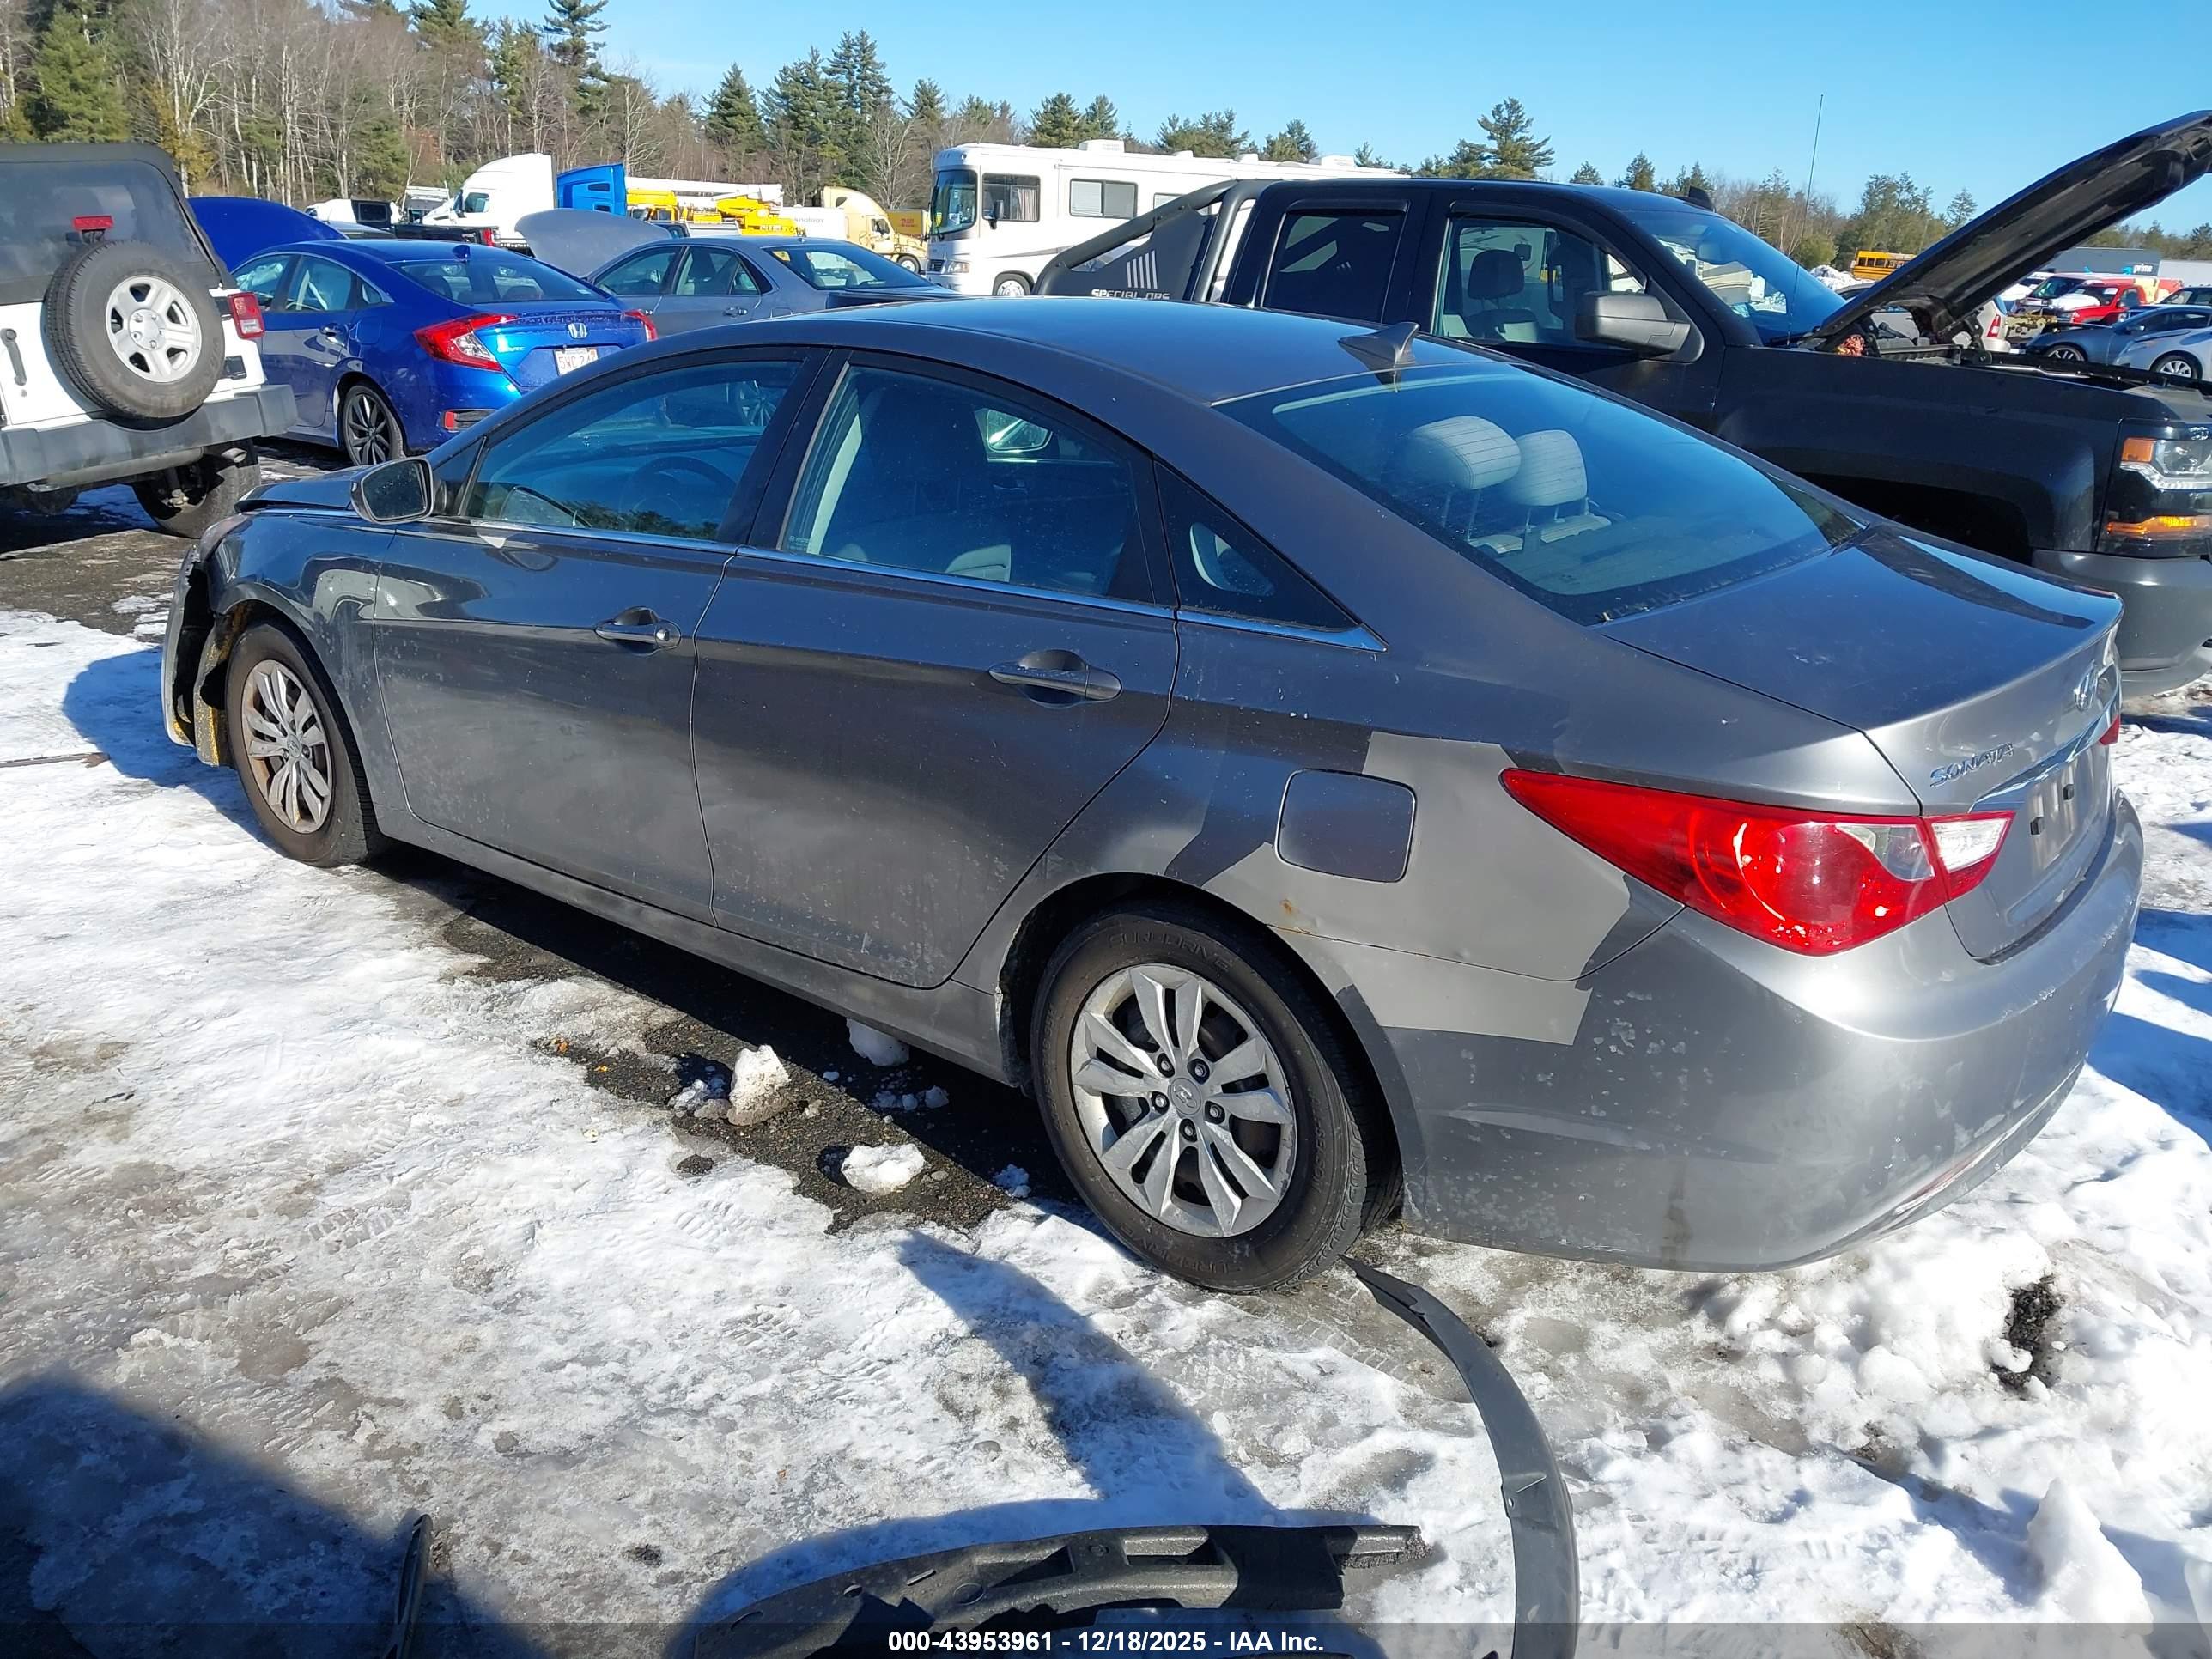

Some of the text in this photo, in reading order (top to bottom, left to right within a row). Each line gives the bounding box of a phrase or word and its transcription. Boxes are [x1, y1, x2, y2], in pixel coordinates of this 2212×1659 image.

[2133, 263, 2153, 274] prime
[1091, 289, 1170, 301] SPECIAL OPS
[1929, 743, 2014, 787] SONATA
